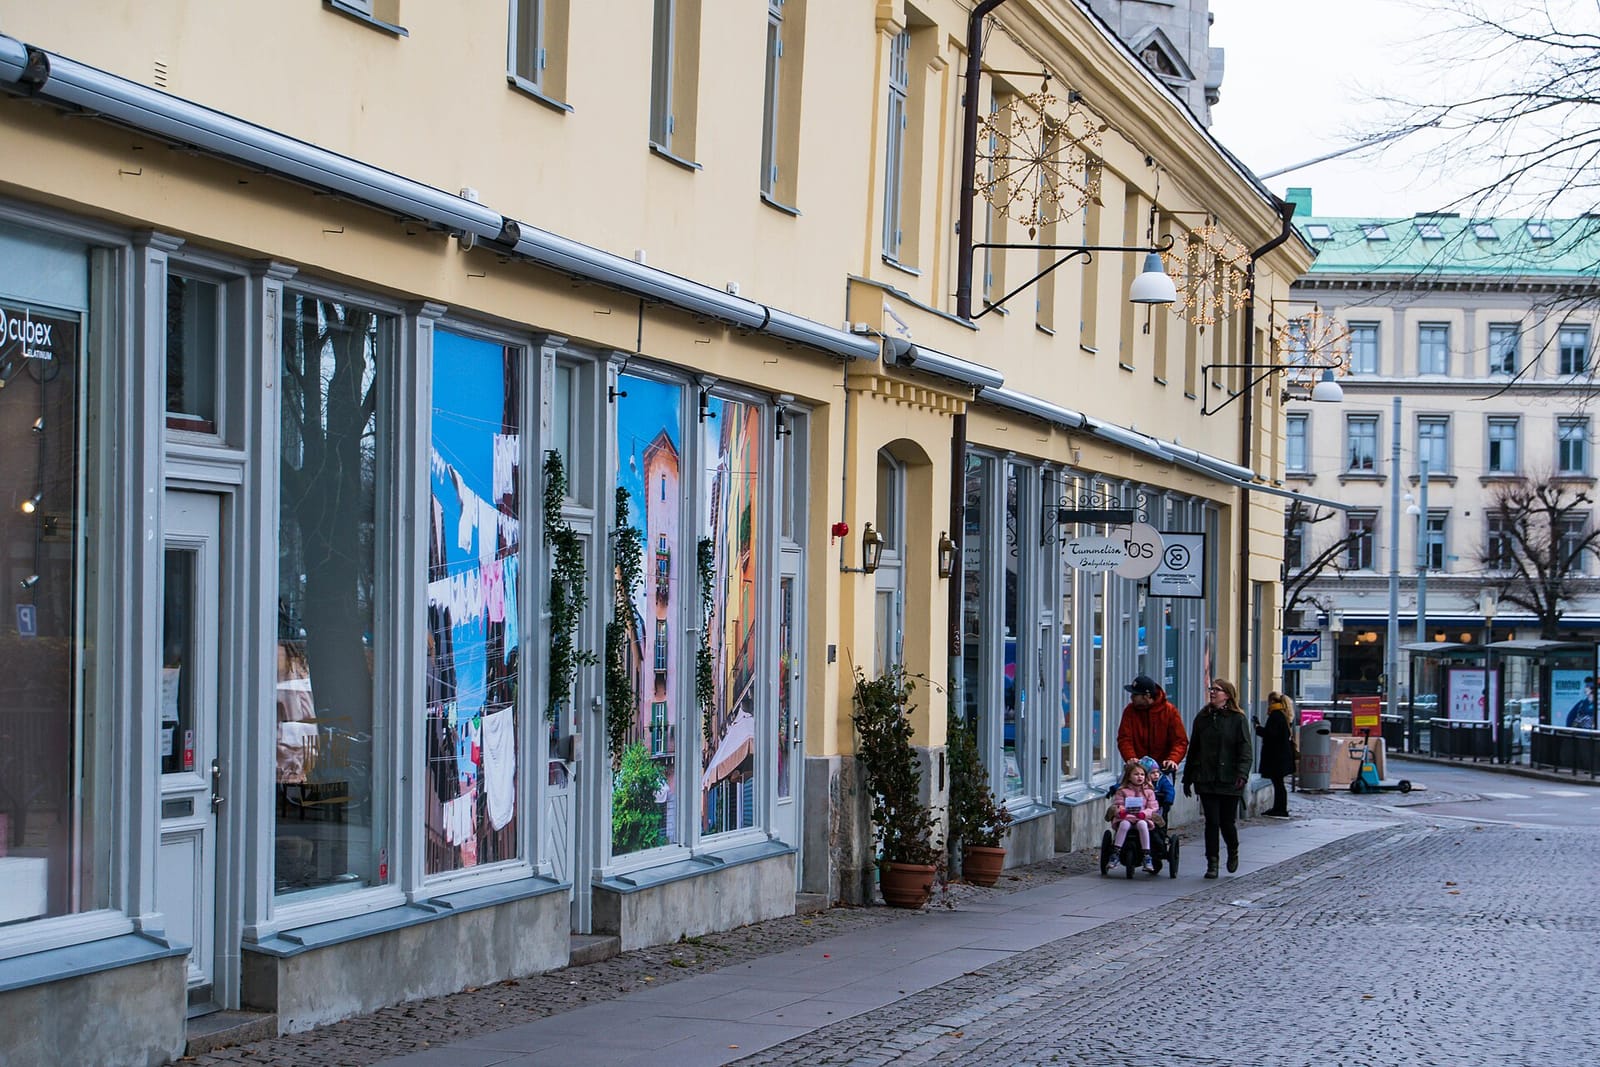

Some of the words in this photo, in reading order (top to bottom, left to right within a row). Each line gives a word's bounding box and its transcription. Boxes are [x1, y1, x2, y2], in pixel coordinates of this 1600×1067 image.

[9, 307, 52, 355] cybex
[1069, 543, 1122, 555] Tummelisa
[1128, 542, 1154, 559] OS
